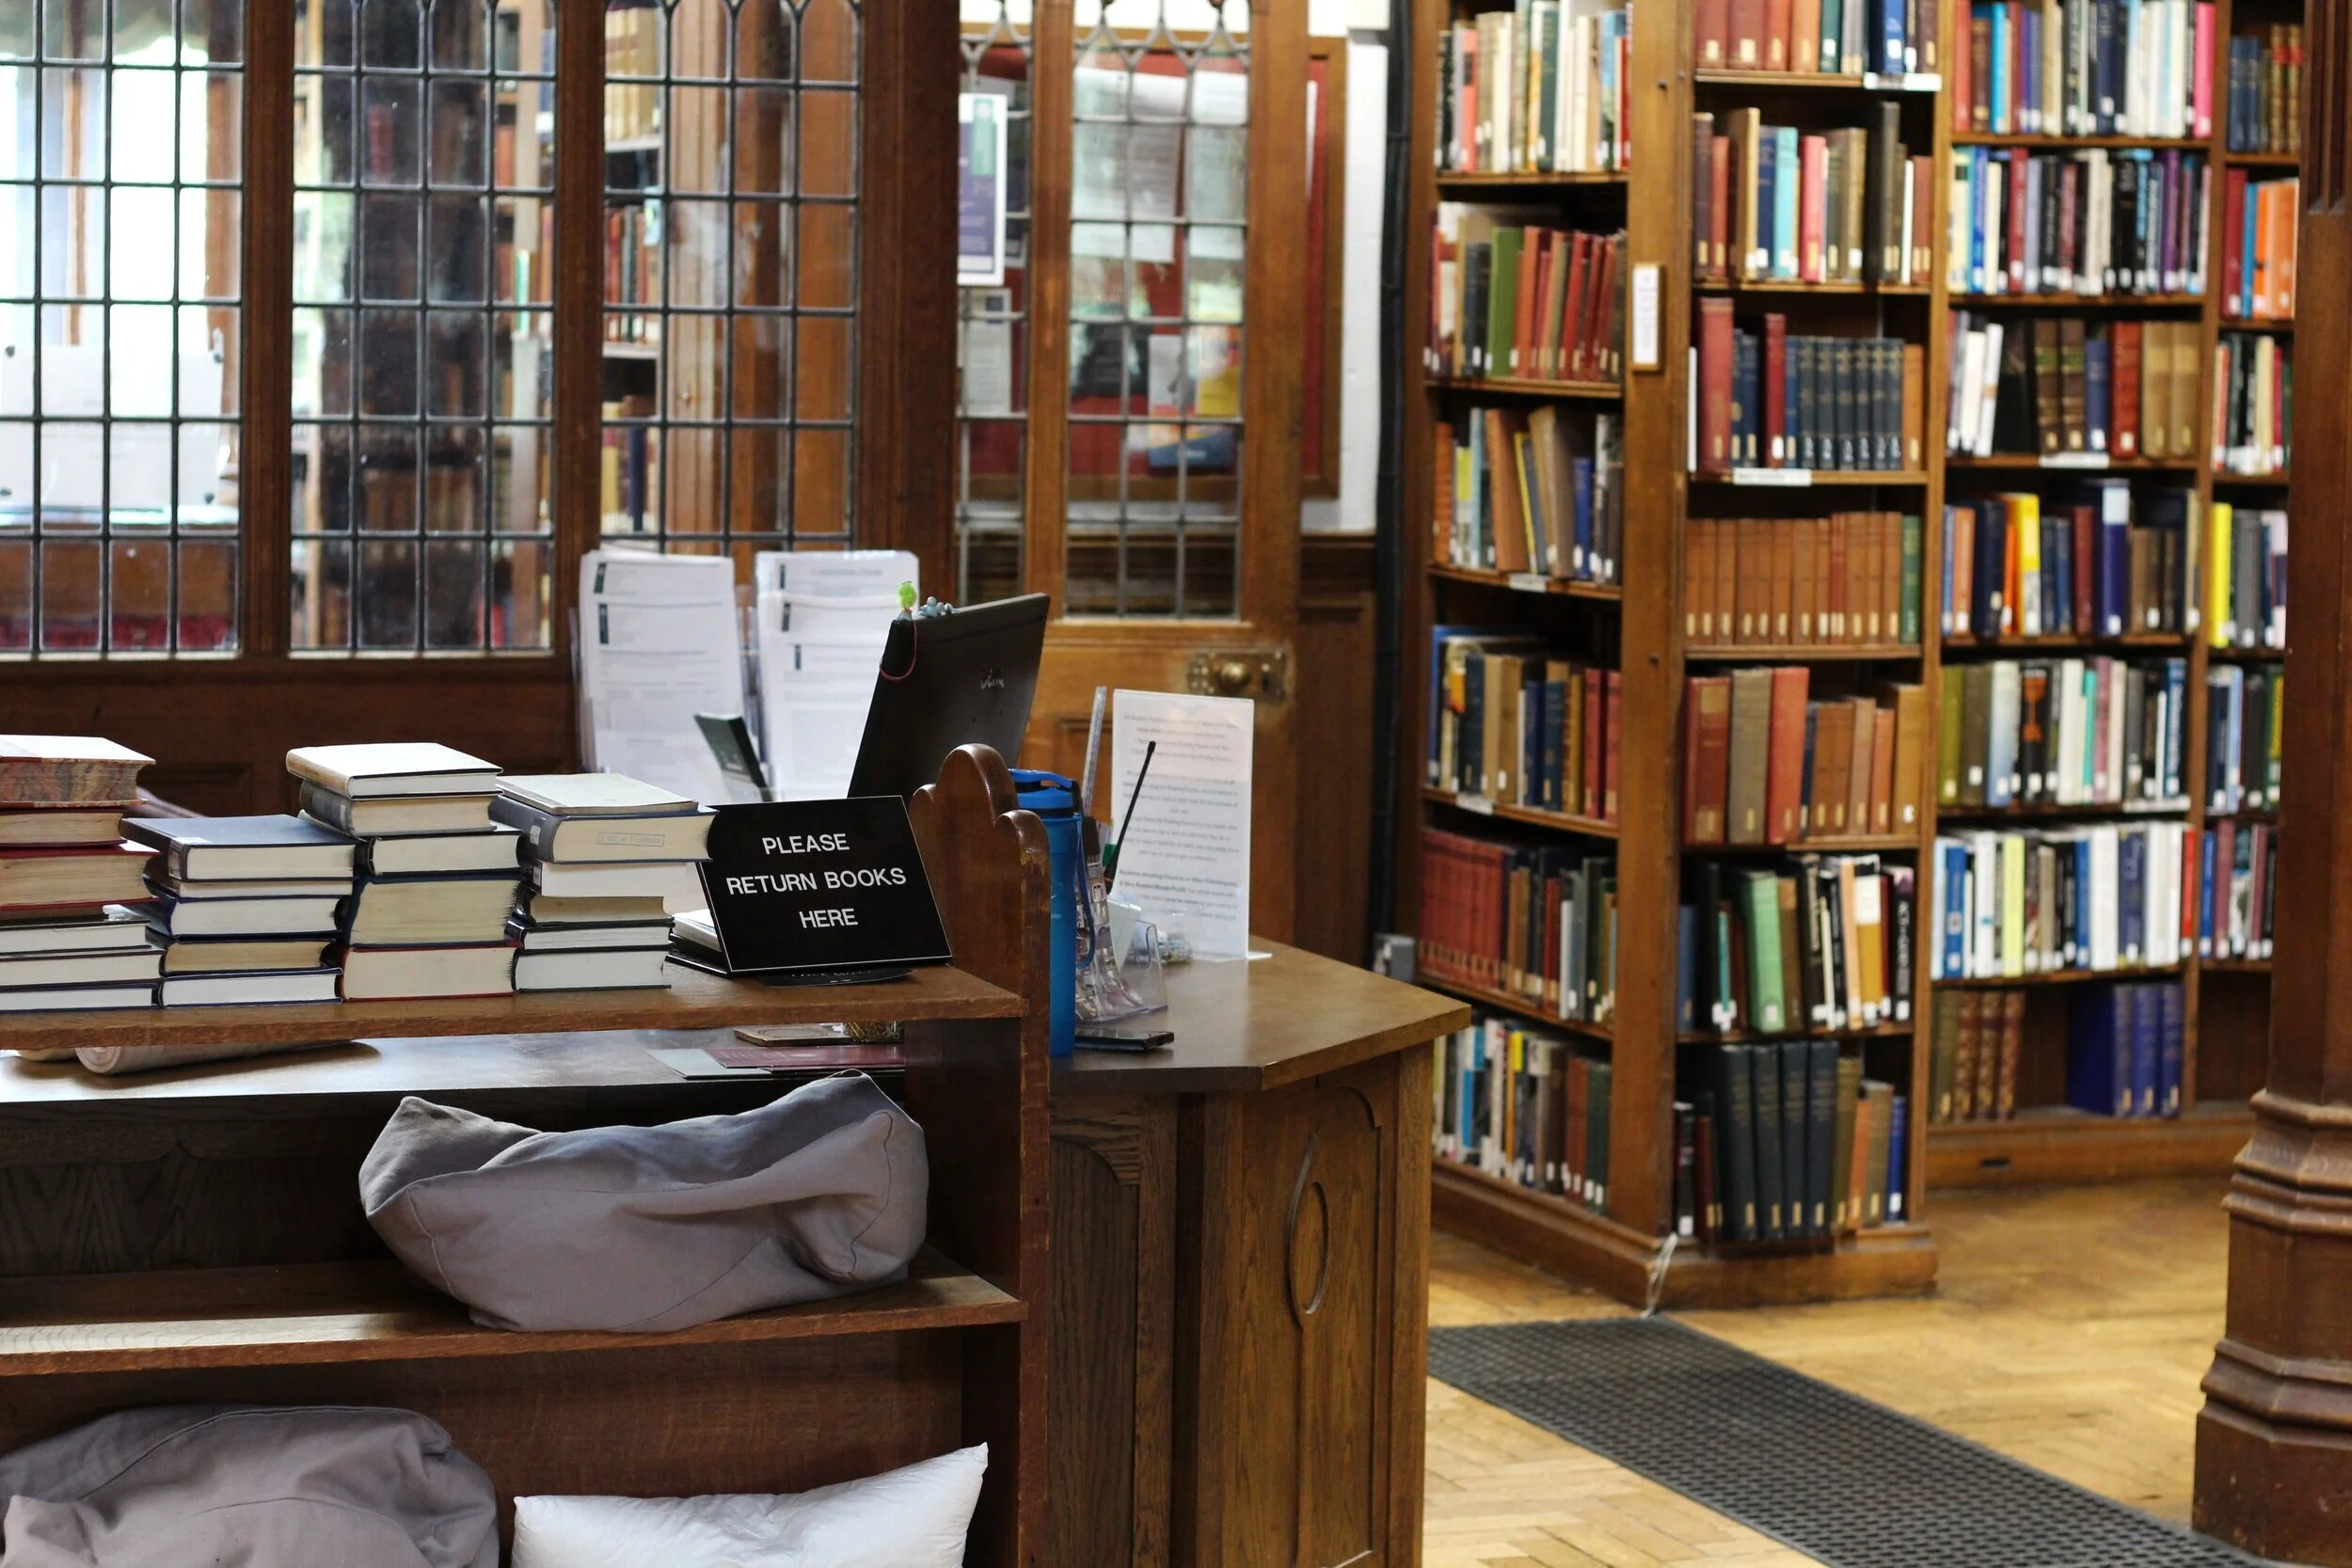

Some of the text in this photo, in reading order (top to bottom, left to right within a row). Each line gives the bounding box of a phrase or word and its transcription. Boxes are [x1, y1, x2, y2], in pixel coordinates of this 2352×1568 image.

[762, 832, 850, 855] PLEASE
[725, 867, 907, 895] RETURN BOOKS
[799, 908, 859, 928] HERE
